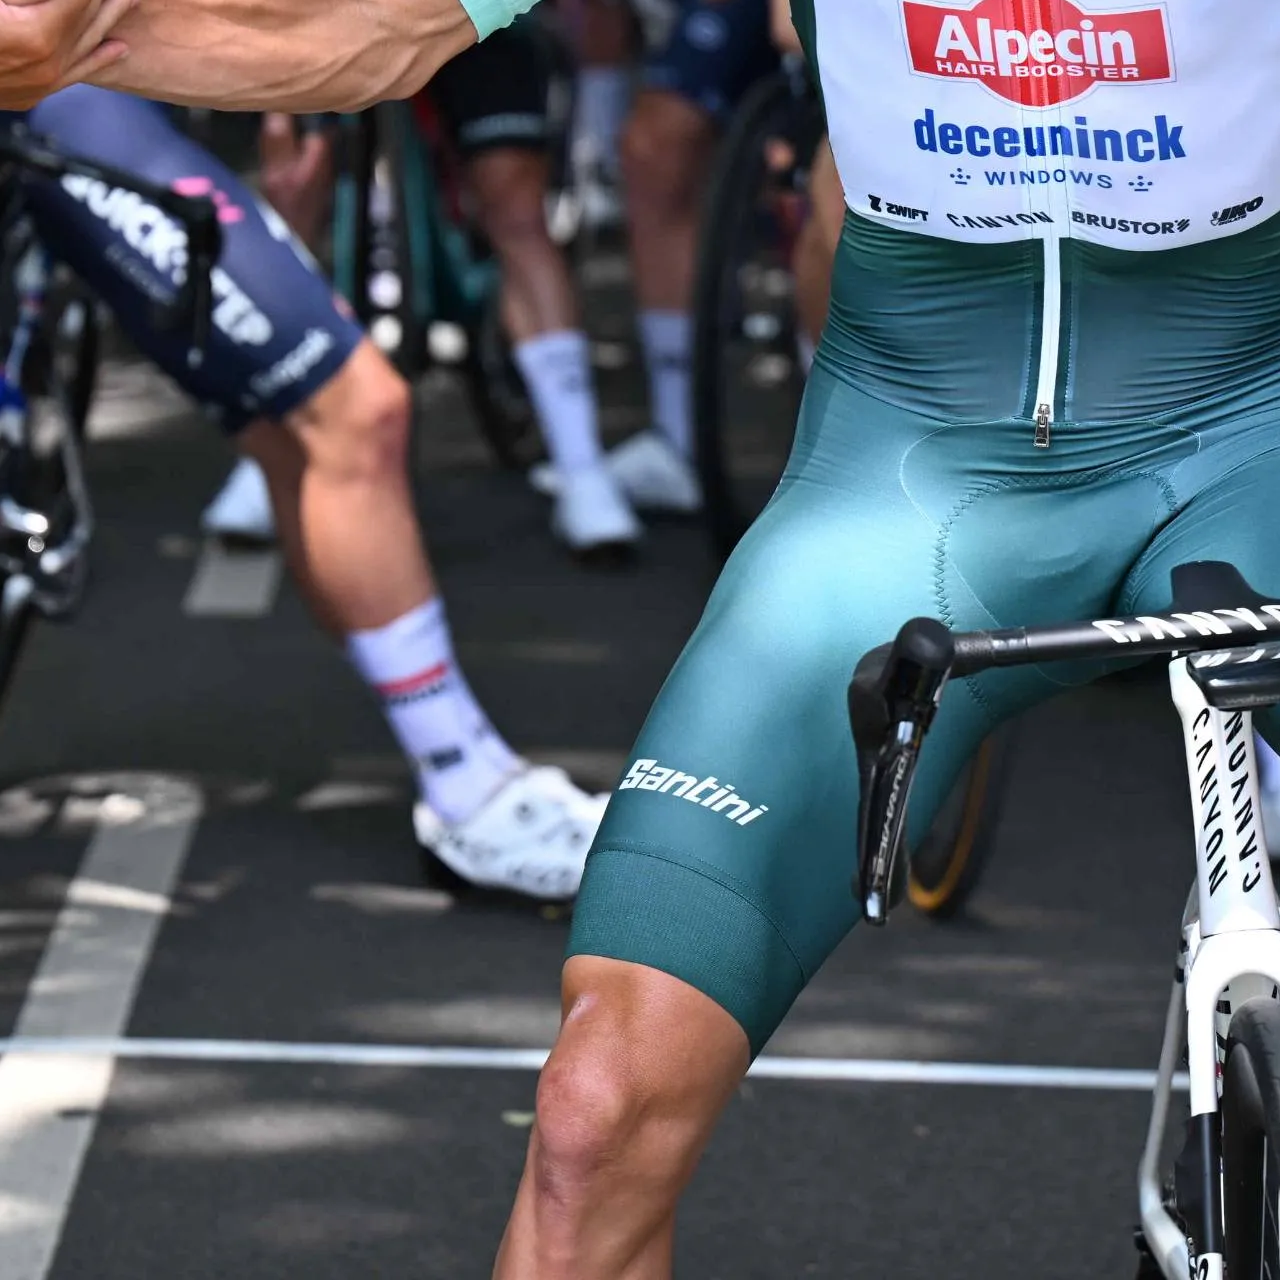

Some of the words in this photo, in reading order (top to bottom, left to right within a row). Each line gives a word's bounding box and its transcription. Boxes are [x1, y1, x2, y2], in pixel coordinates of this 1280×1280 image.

[933, 14, 1137, 77] Alpecin
[936, 60, 997, 76] HAIR
[1014, 64, 1140, 79] BOOSTER
[913, 108, 1187, 163] deceuninck
[985, 168, 1113, 189] WINDOWS
[885, 202, 928, 222] ZWIFT
[946, 211, 1054, 229] CANYON
[1072, 210, 1176, 235] BRUSTOR
[619, 758, 769, 826] Santini
[1192, 707, 1228, 897] CANYON
[1224, 712, 1262, 893] CANYON
